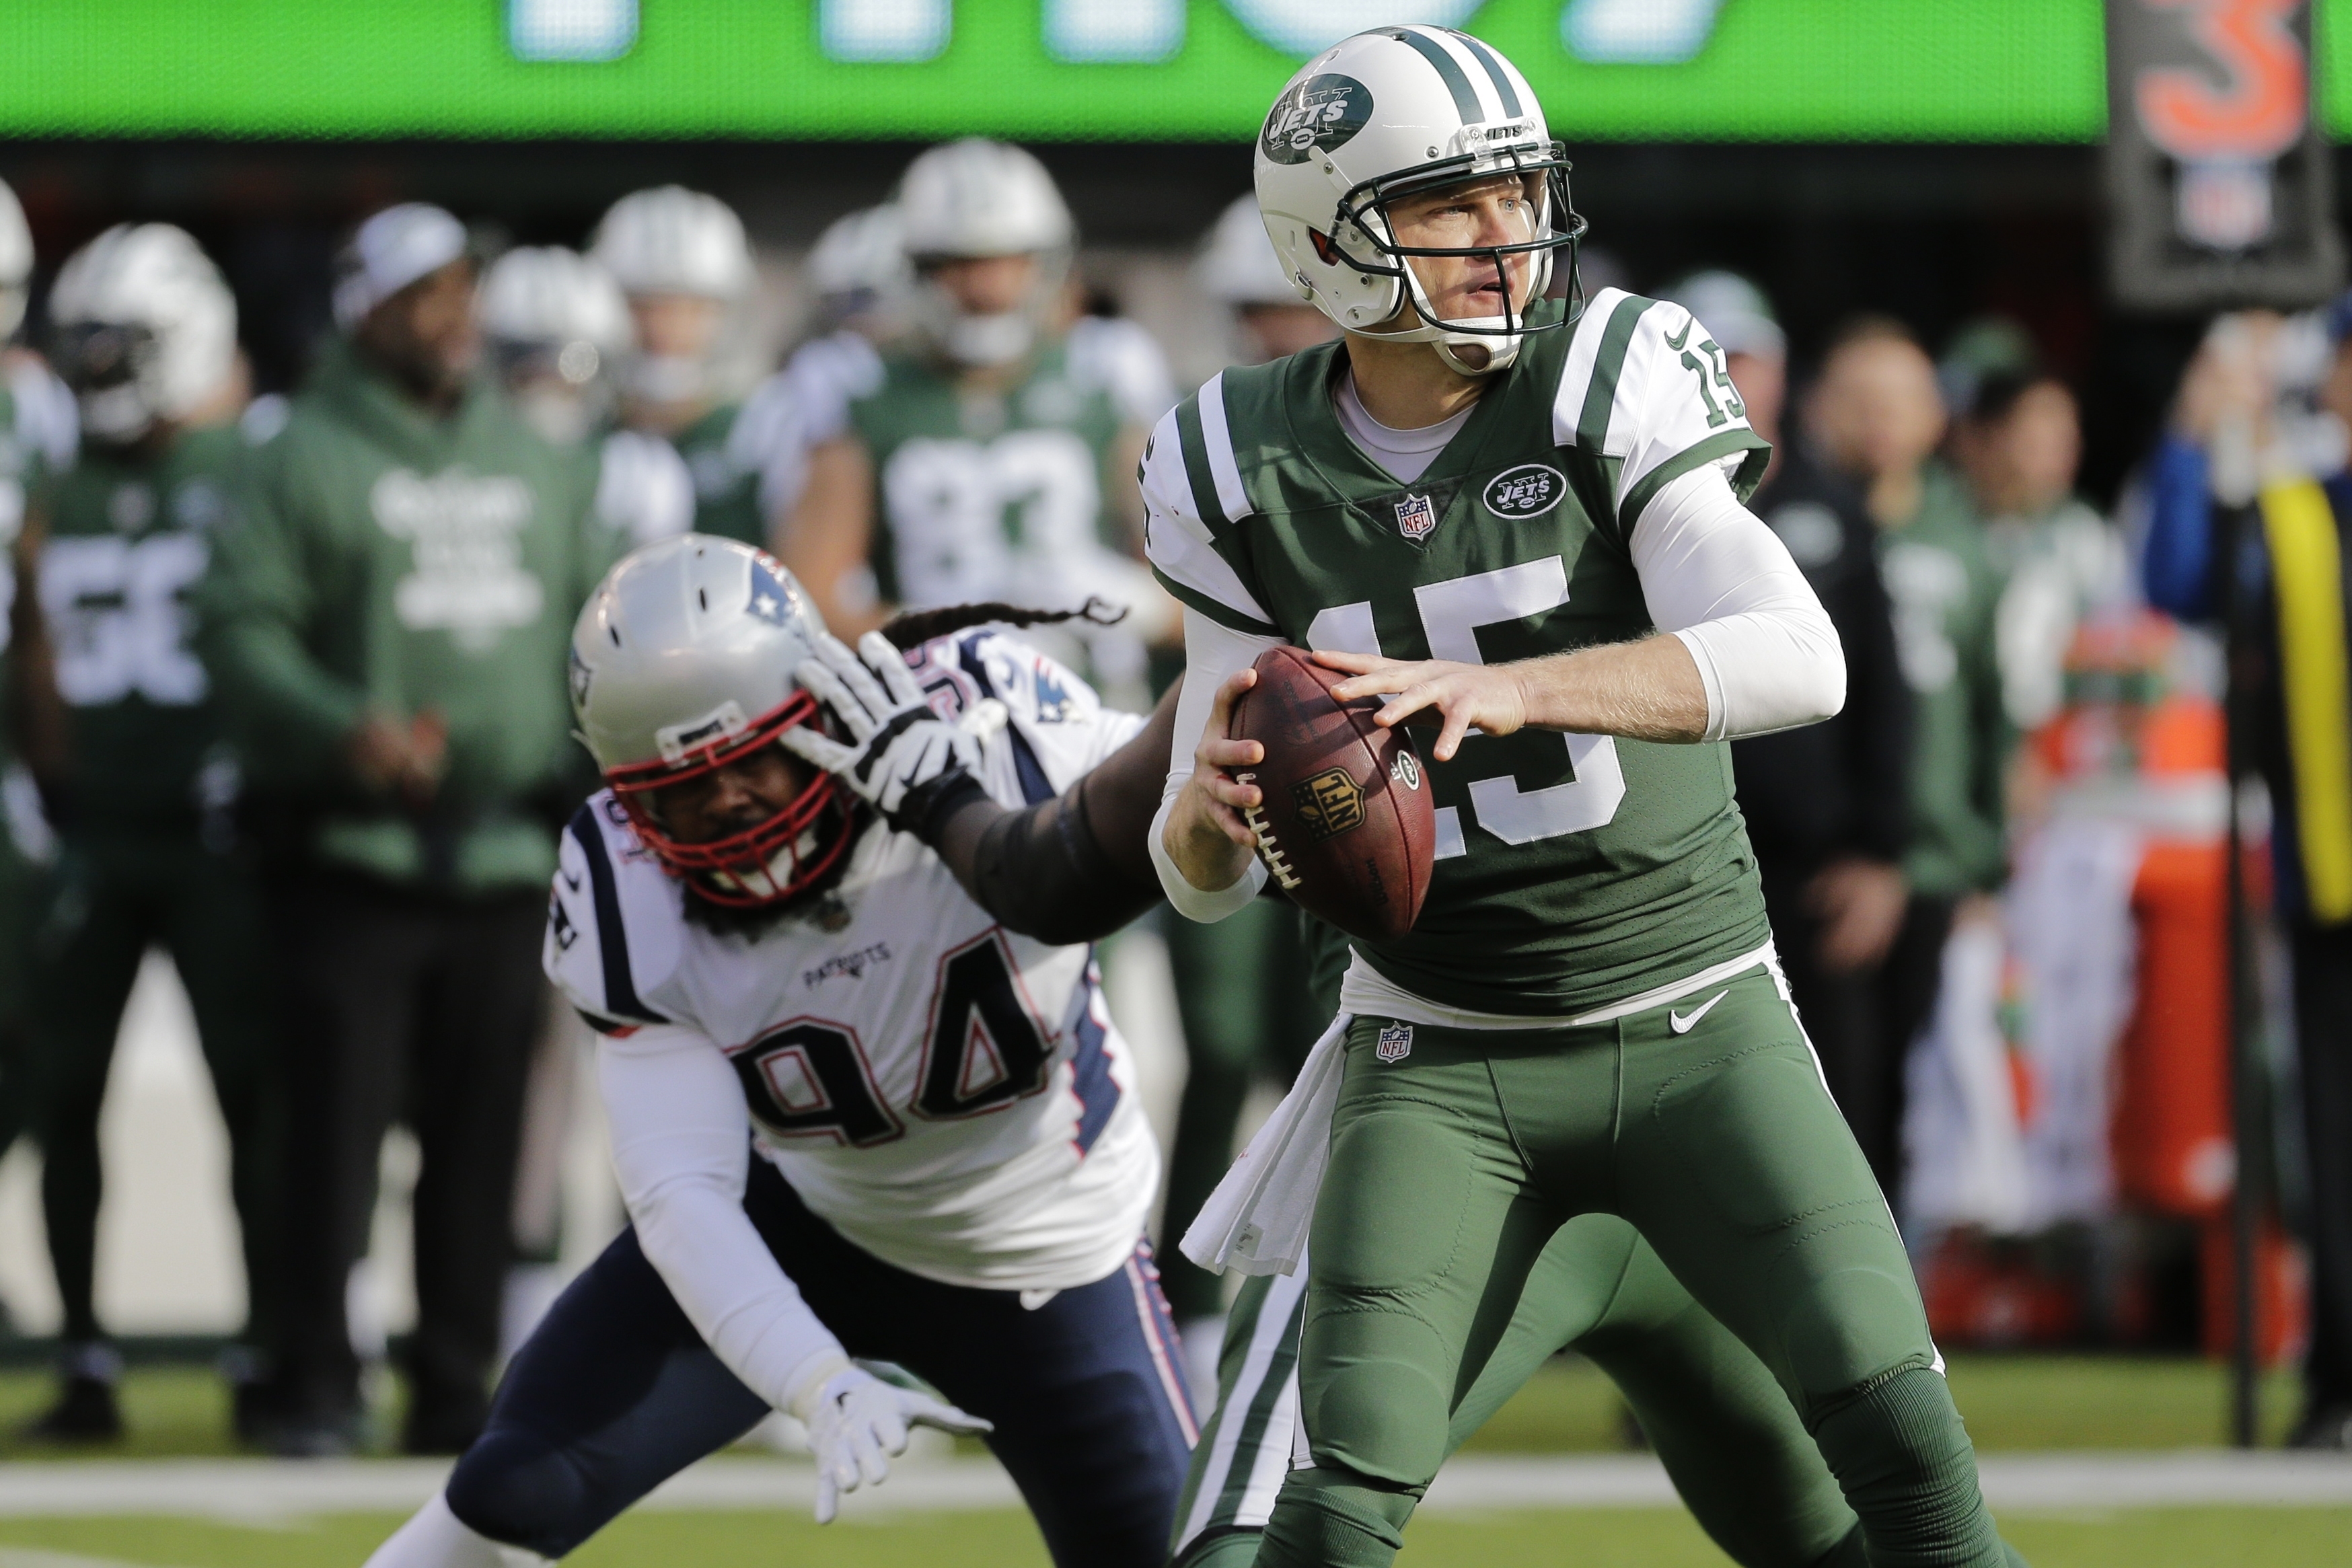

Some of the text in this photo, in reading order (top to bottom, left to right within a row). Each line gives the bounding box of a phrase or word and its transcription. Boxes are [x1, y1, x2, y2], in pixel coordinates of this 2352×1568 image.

[1269, 100, 1348, 140] JETS
[1485, 124, 1523, 141] JETS
[1681, 339, 1744, 429] 15
[1496, 480, 1550, 504] JETS
[1403, 514, 1429, 532] NFL
[1315, 774, 1358, 829] NFL
[803, 942, 891, 991] PATRIOTS
[723, 926, 1061, 1148] 94
[1381, 1041, 1405, 1056] NFL
